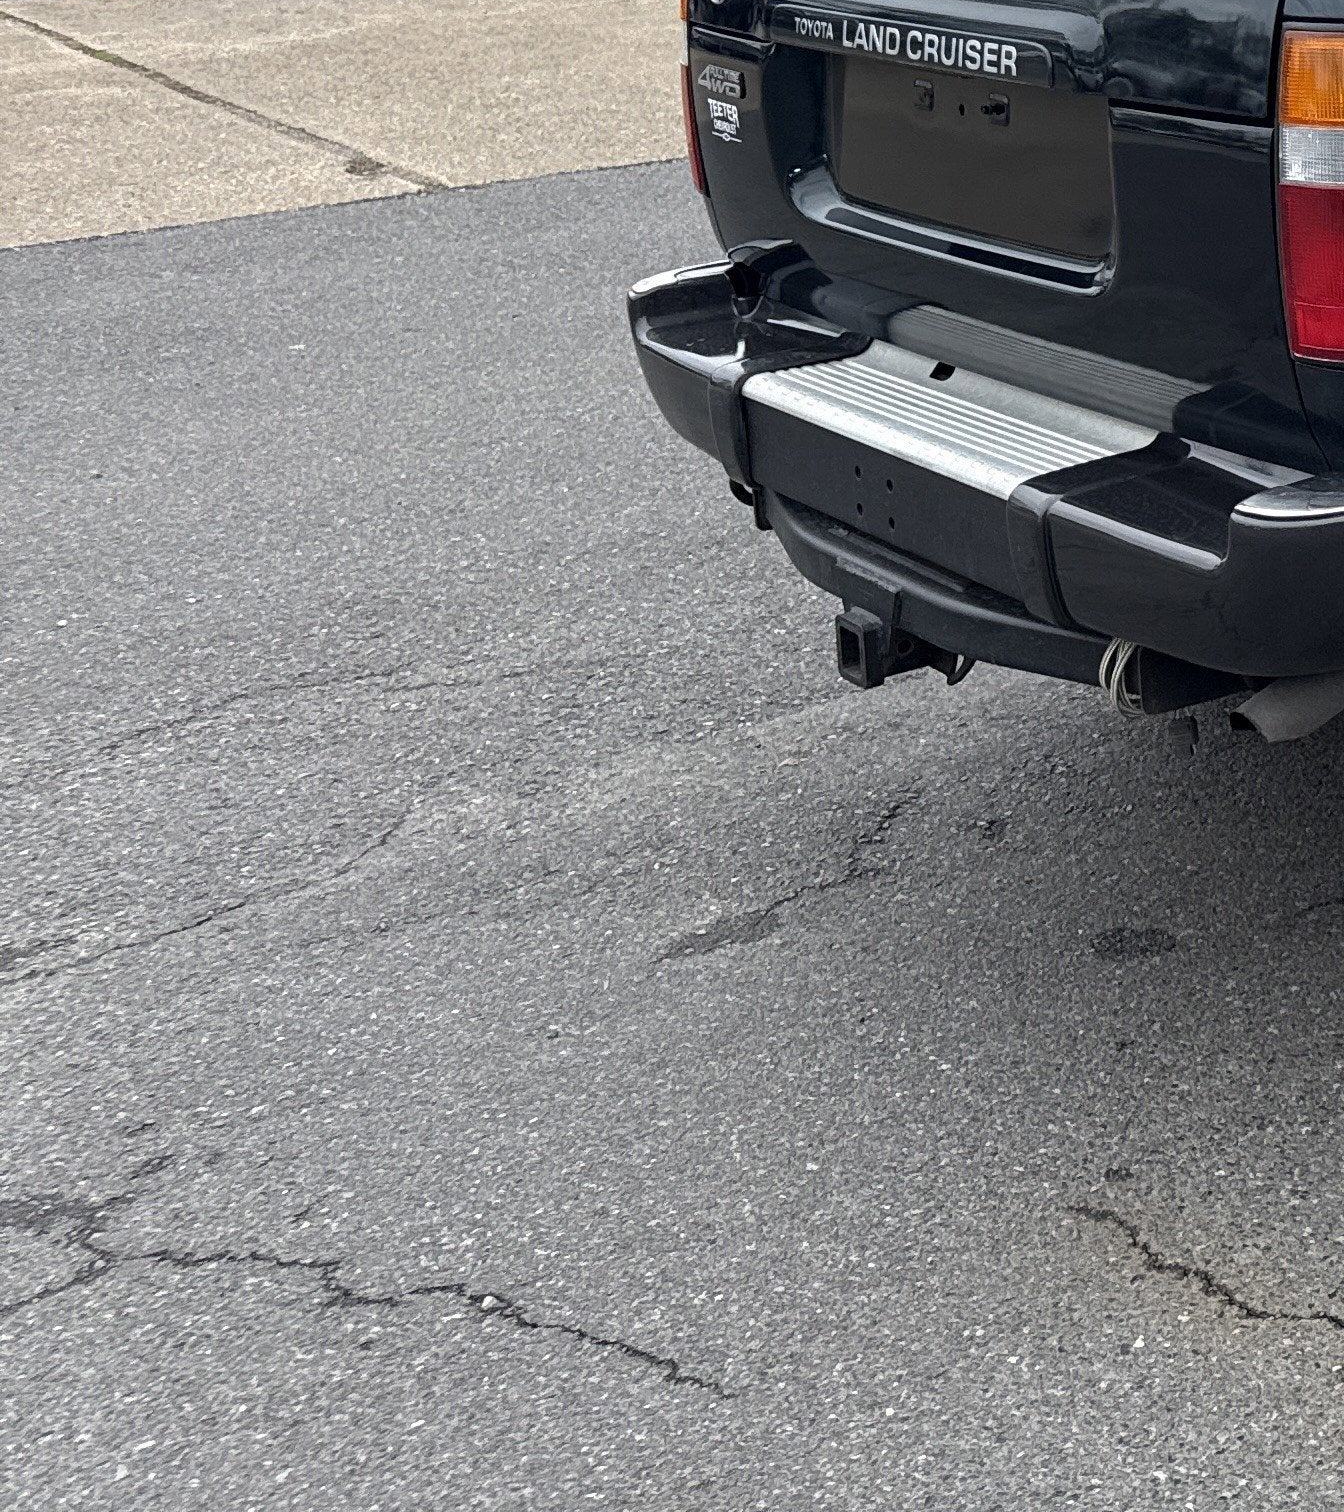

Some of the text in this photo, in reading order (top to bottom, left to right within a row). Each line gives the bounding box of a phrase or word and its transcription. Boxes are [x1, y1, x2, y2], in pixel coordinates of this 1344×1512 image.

[795, 17, 1018, 77] TOYOTA LAND CRUISER
[707, 98, 740, 128] TEETER
